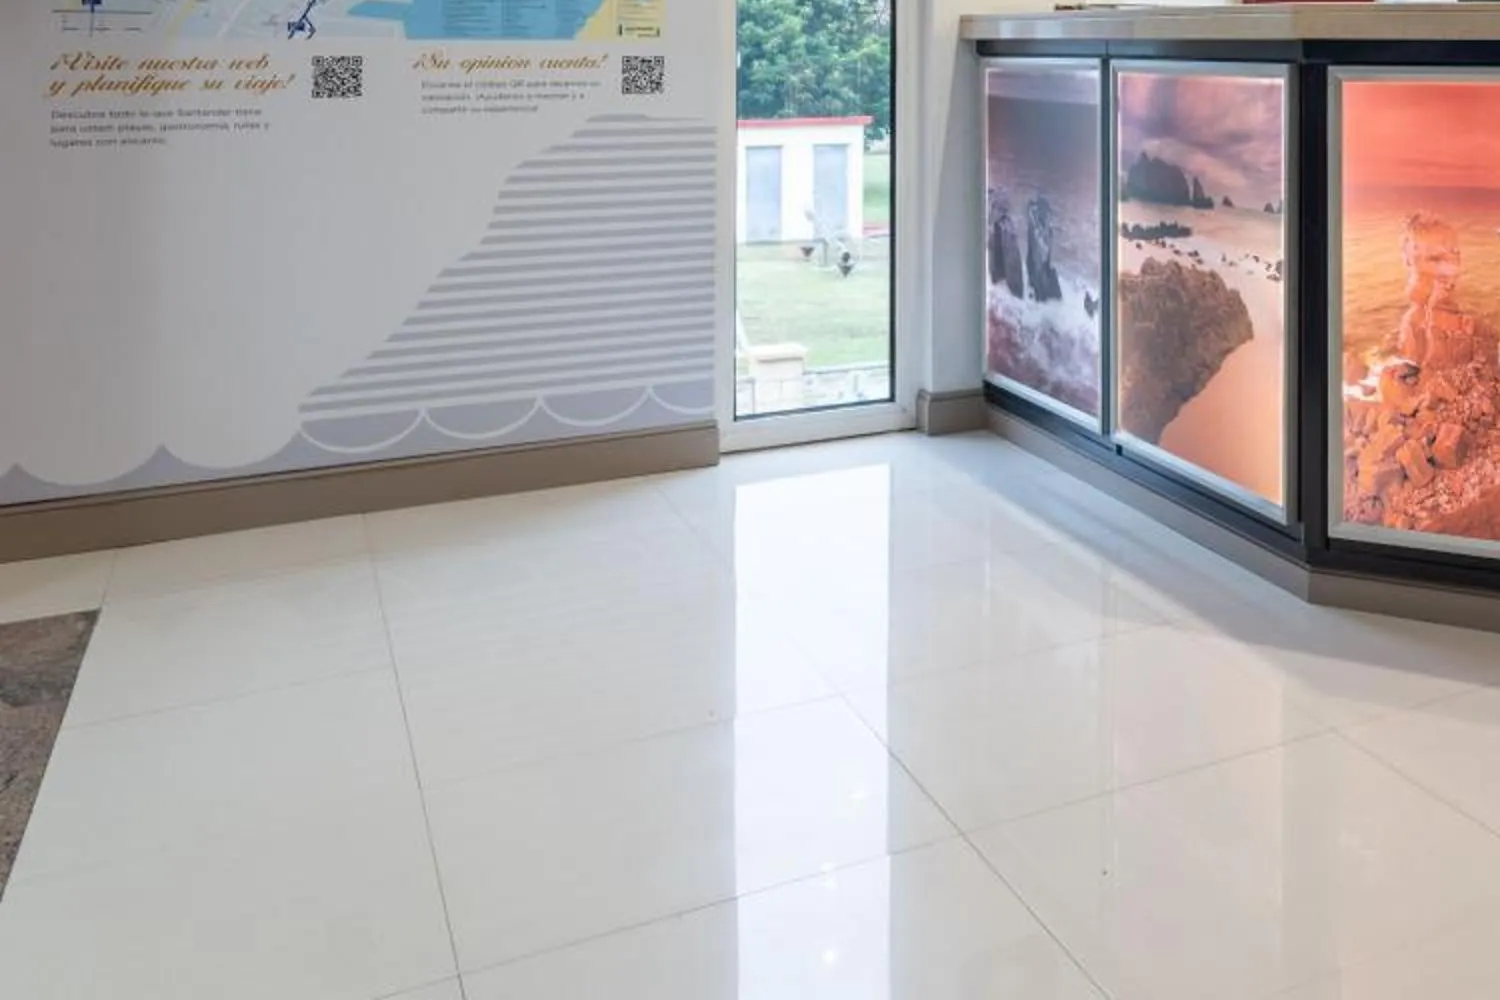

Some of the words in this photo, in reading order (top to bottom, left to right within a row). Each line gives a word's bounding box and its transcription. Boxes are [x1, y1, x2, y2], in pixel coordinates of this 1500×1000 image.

[137, 56, 218, 71] nuestra
[228, 53, 270, 71] web
[49, 79, 66, 97] y
[70, 74, 190, 97] planifique
[200, 79, 224, 91] su
[234, 73, 297, 96] viaje!
